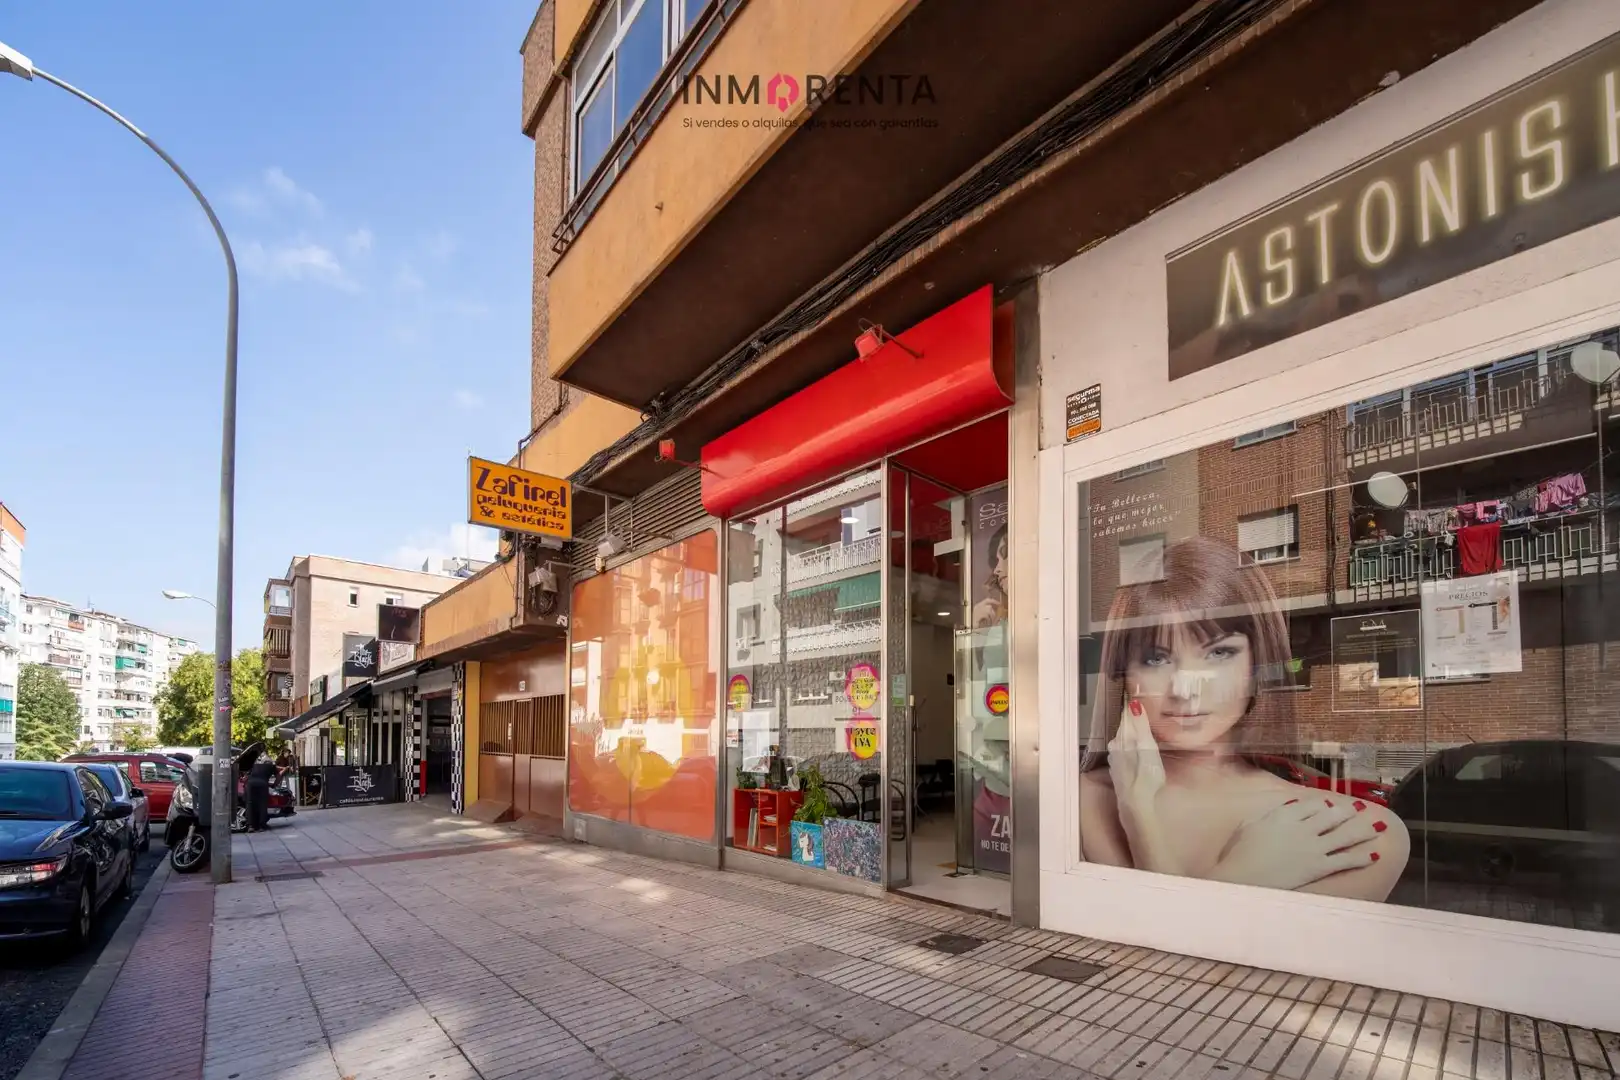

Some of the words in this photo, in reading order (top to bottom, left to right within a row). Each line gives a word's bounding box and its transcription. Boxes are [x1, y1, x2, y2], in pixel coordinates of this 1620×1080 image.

[1067, 409, 1100, 424] CONECTADA
[475, 466, 567, 508] Zafirel
[480, 506, 495, 518] &
[1093, 516, 1103, 525] lo
[1093, 523, 1137, 538] sabemos
[1448, 591, 1489, 601] PRECIOS
[980, 839, 990, 850] NO
[991, 840, 999, 852] TE
